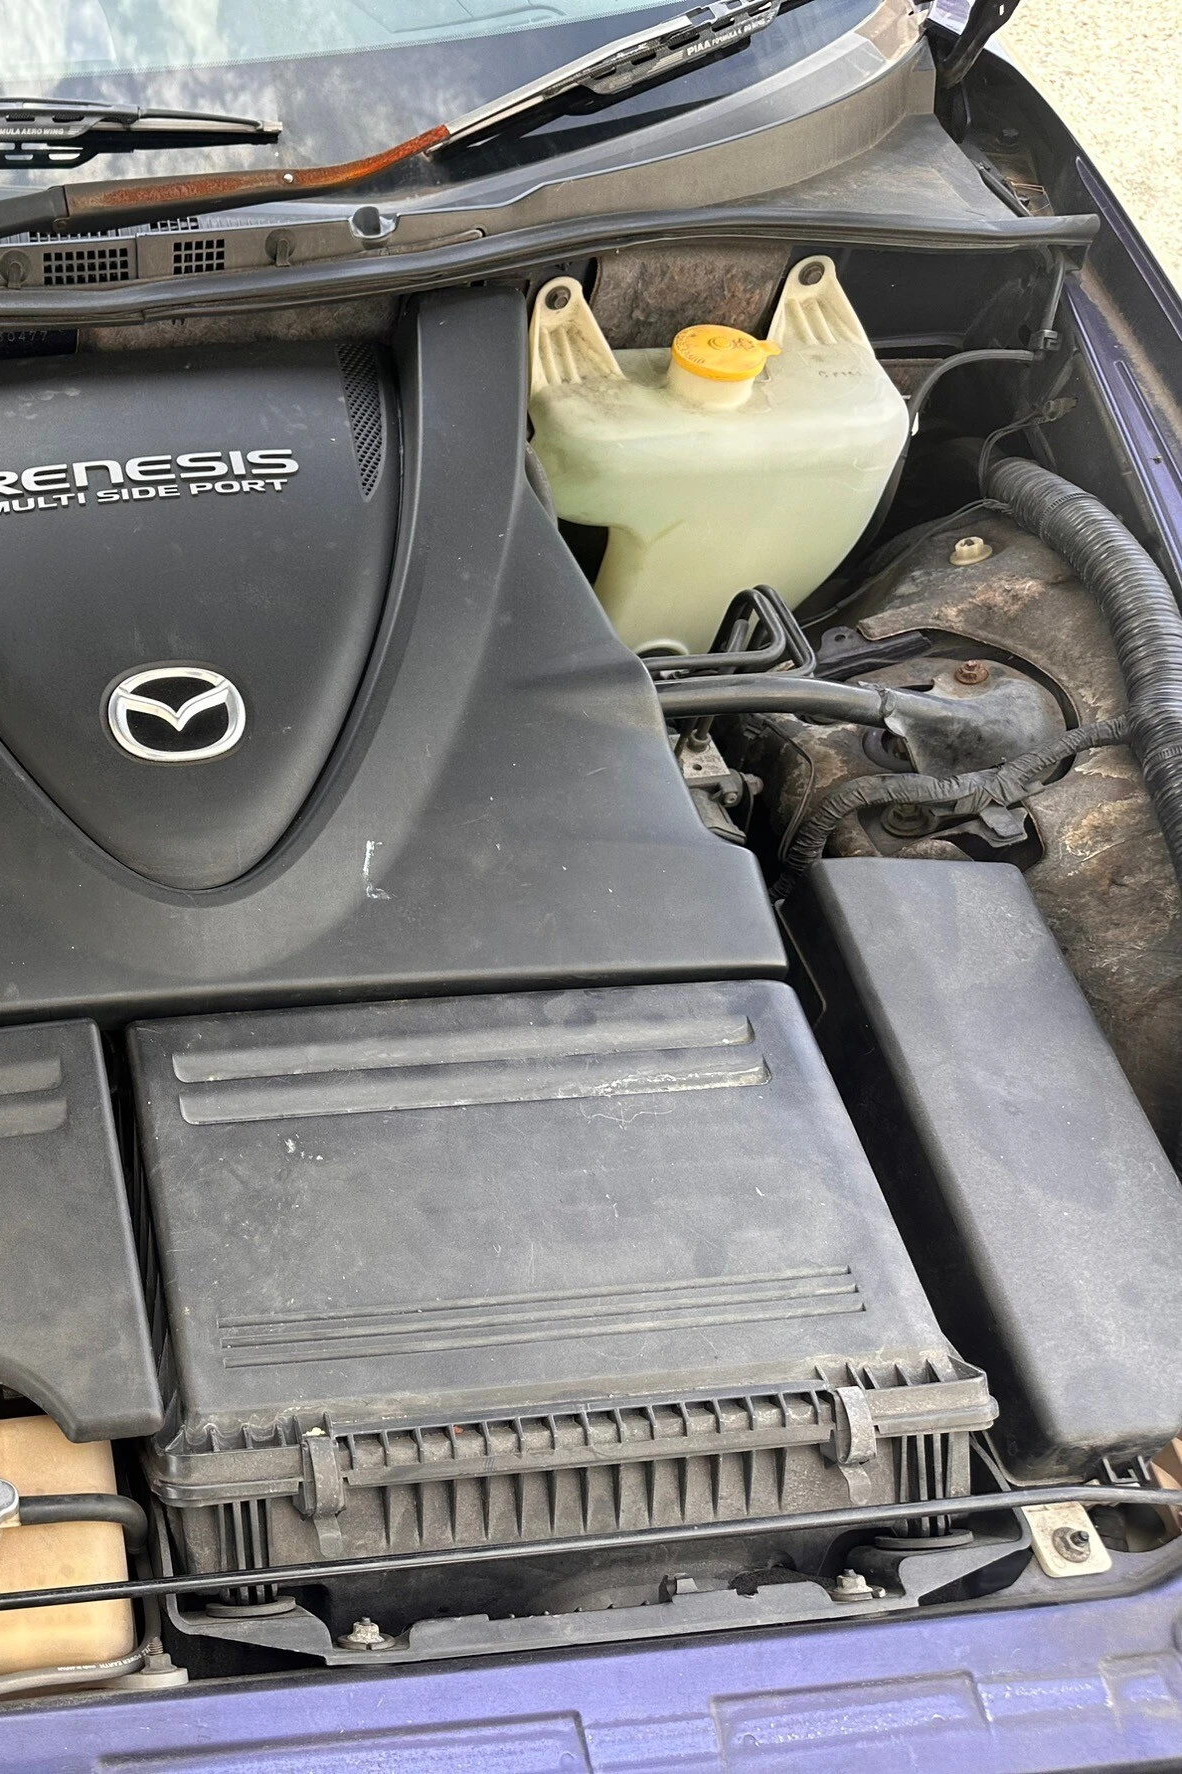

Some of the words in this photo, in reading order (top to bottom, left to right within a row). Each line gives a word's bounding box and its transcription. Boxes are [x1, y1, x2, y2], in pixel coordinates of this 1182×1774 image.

[687, 41, 711, 55] PIAA
[97, 484, 181, 503] SIDE
[189, 479, 288, 495] PORT
[99, 1660, 123, 1669] EARTH
